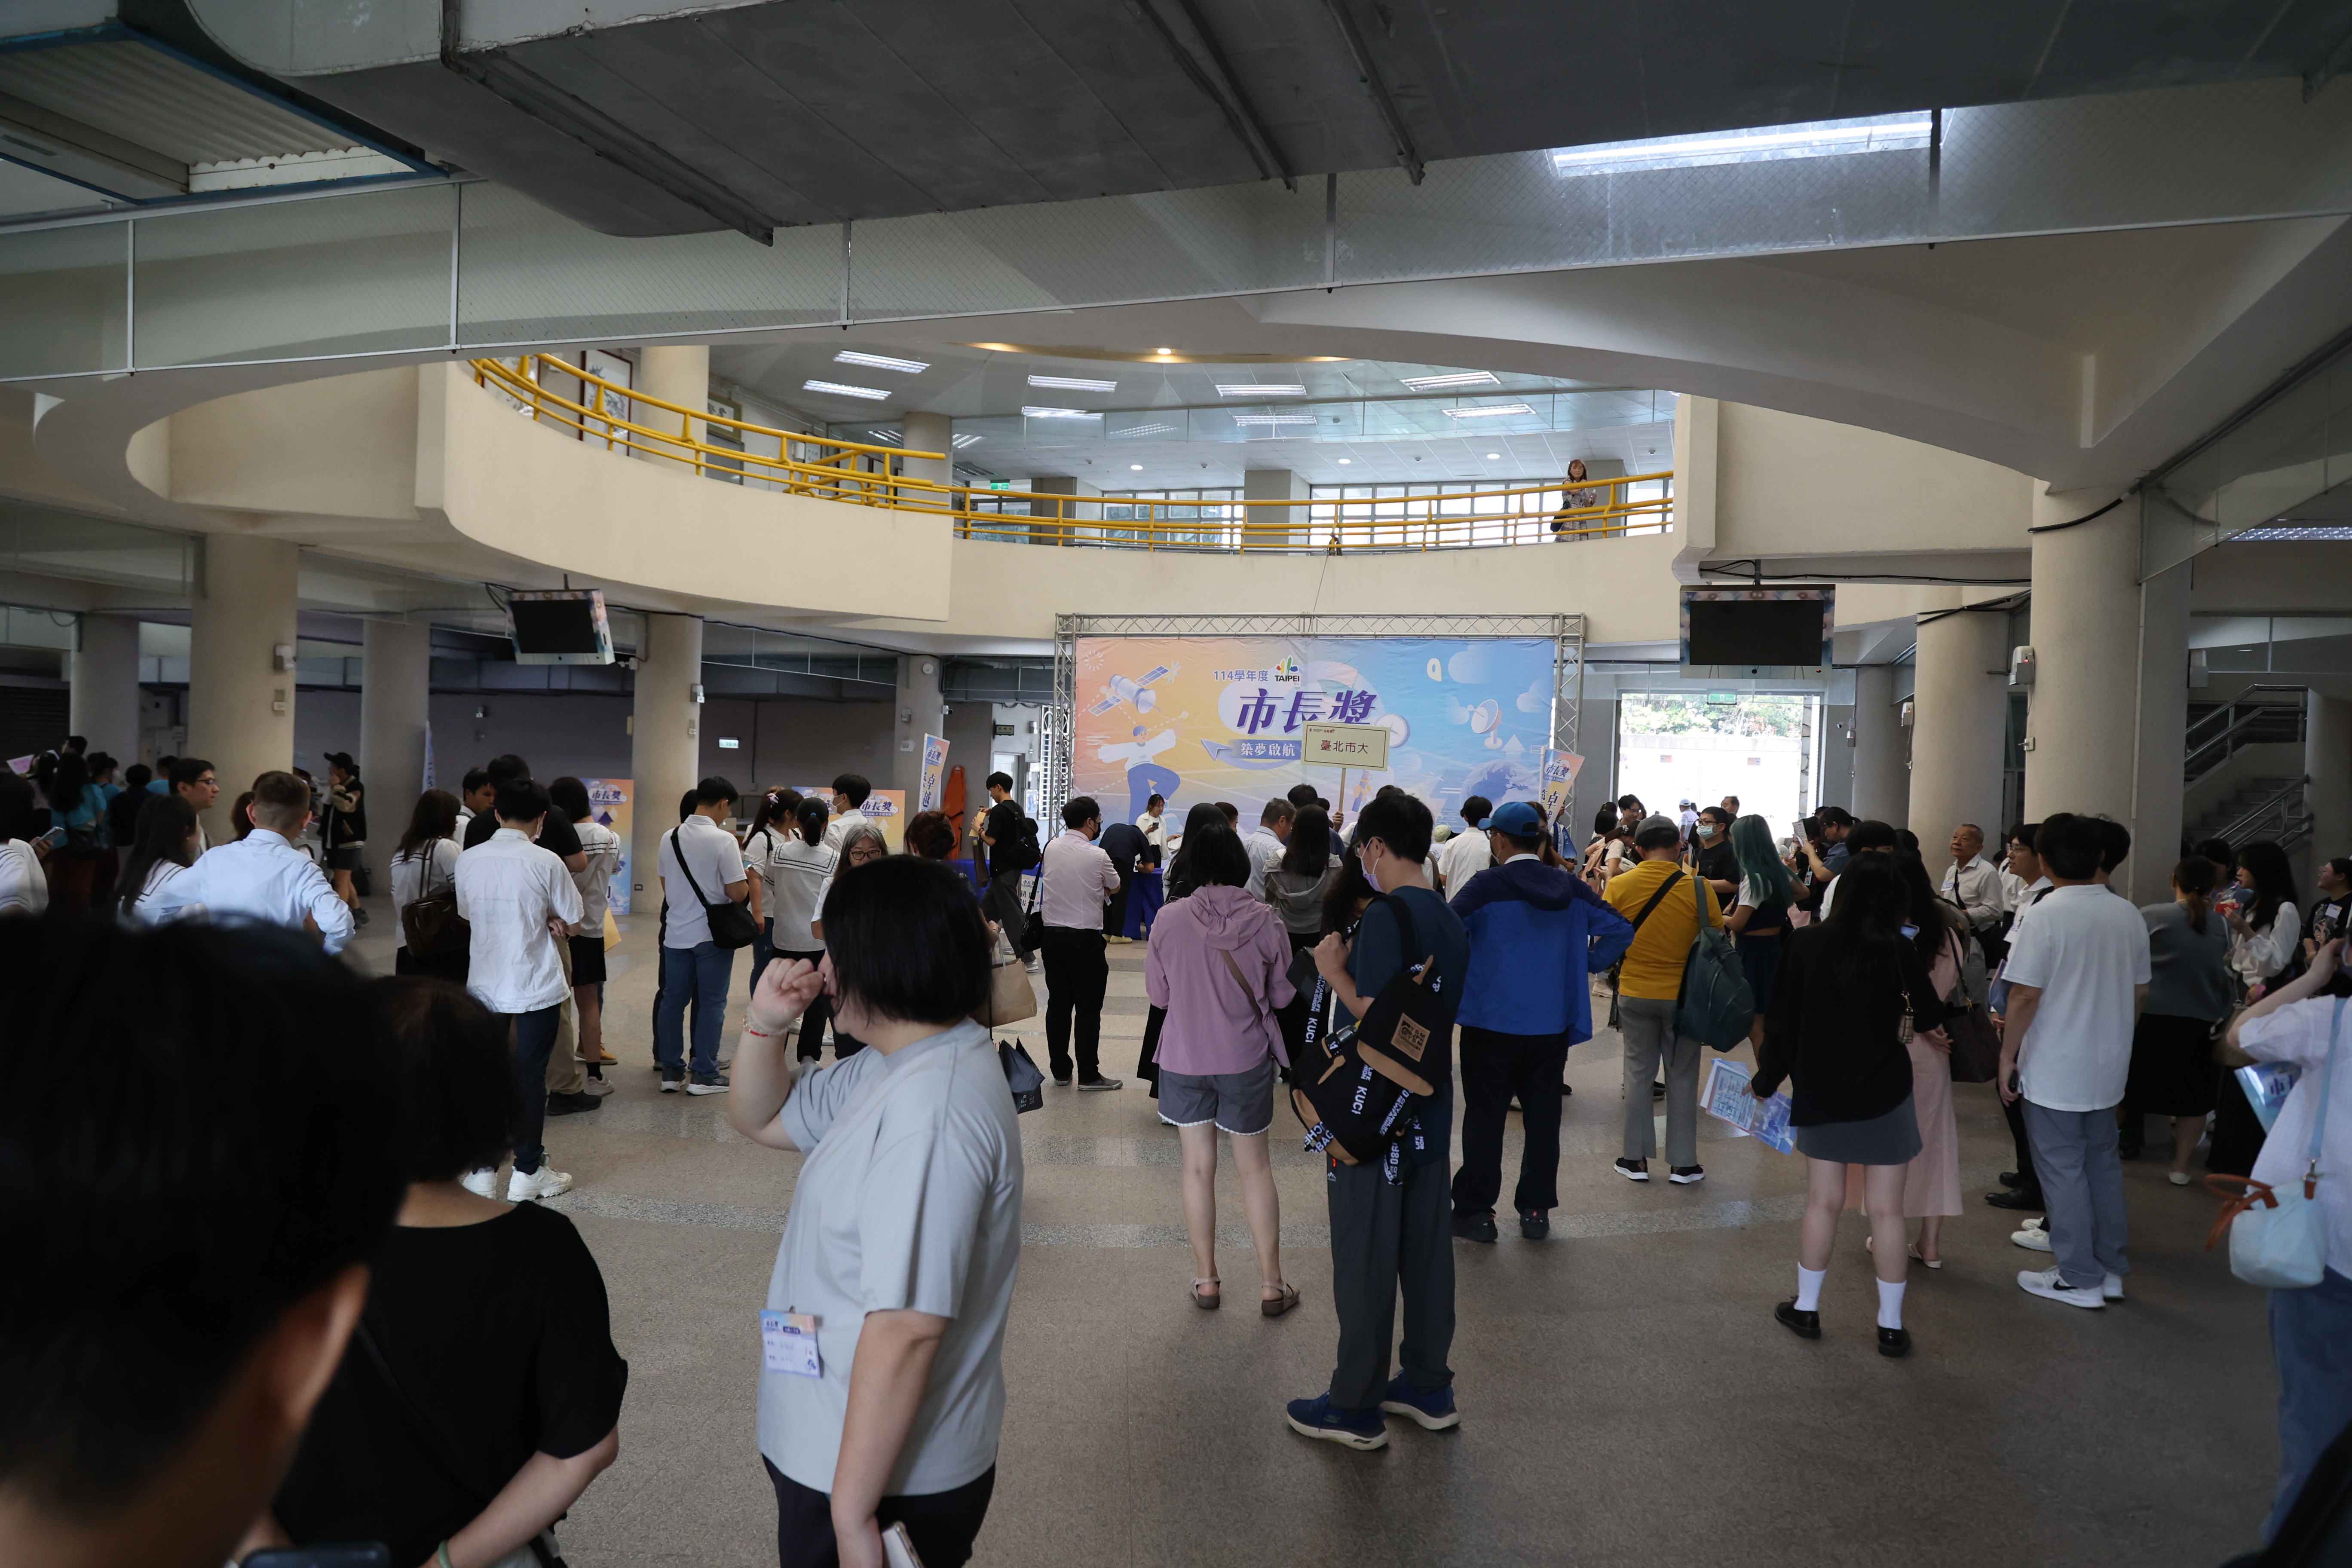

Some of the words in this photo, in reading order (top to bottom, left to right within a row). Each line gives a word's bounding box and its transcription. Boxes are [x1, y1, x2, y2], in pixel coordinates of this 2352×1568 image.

[1214, 670, 1268, 682] 114學年度
[1237, 688, 1377, 735] 市長獎
[1241, 742, 1295, 757] 築夢啟航
[1320, 740, 1369, 754] 臺北市大
[1546, 764, 1570, 778] 市長獎
[862, 801, 892, 812] 市長獎
